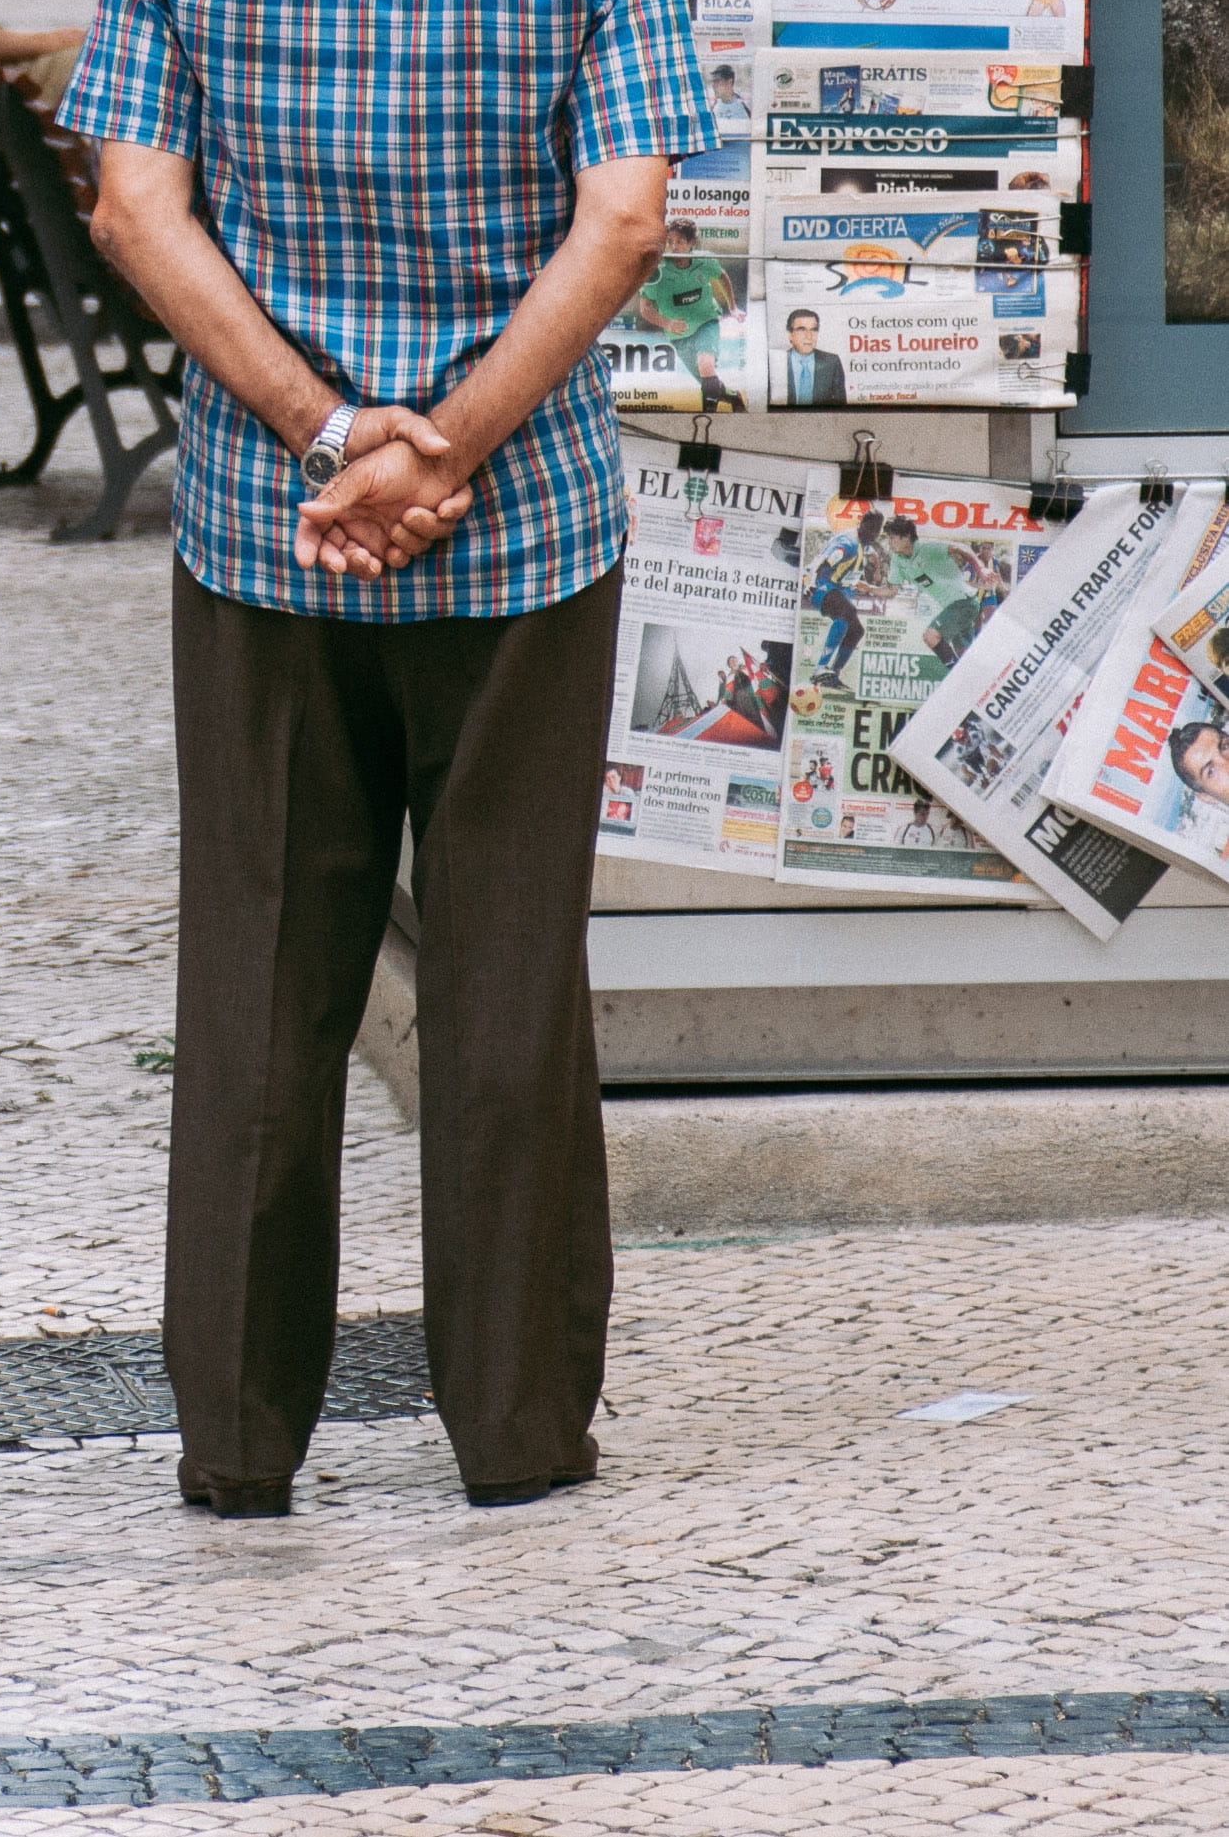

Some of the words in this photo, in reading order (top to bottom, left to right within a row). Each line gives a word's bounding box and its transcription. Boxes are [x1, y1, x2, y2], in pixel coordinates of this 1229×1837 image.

[860, 64, 928, 81] GRÁTIS
[770, 118, 950, 154] Expresso
[682, 190, 692, 200] o
[693, 185, 751, 205] losango
[669, 206, 718, 219] avançado
[718, 205, 751, 217] Falcao
[699, 228, 741, 239] TERCEIRO
[787, 219, 831, 239] DVD
[835, 216, 909, 238] OFERTA
[848, 316, 868, 330] Os
[871, 315, 914, 330] factos
[916, 316, 949, 328] com
[951, 315, 980, 331] que
[849, 334, 893, 354] Dias
[897, 332, 980, 353] Loureiro
[848, 358, 868, 374] foi
[871, 357, 962, 373] confrontado
[633, 387, 659, 400] bem
[637, 467, 681, 501] EL
[893, 496, 1045, 532] BOLA
[644, 559, 664, 573] en
[668, 559, 729, 583] Francia
[732, 569, 742, 584] 3
[643, 574, 669, 592] del
[672, 581, 738, 603] aparato
[741, 589, 798, 611] militar
[984, 608, 1079, 722] CANCELLARA
[1070, 537, 1136, 612] FRAPPE
[1173, 611, 1211, 649] FREE
[862, 652, 920, 678] MATÍAS
[647, 765, 663, 780] La
[663, 770, 712, 787] primera
[644, 782, 699, 800] española
[699, 790, 722, 802] con
[643, 796, 664, 809] dos
[666, 799, 712, 815] madres
